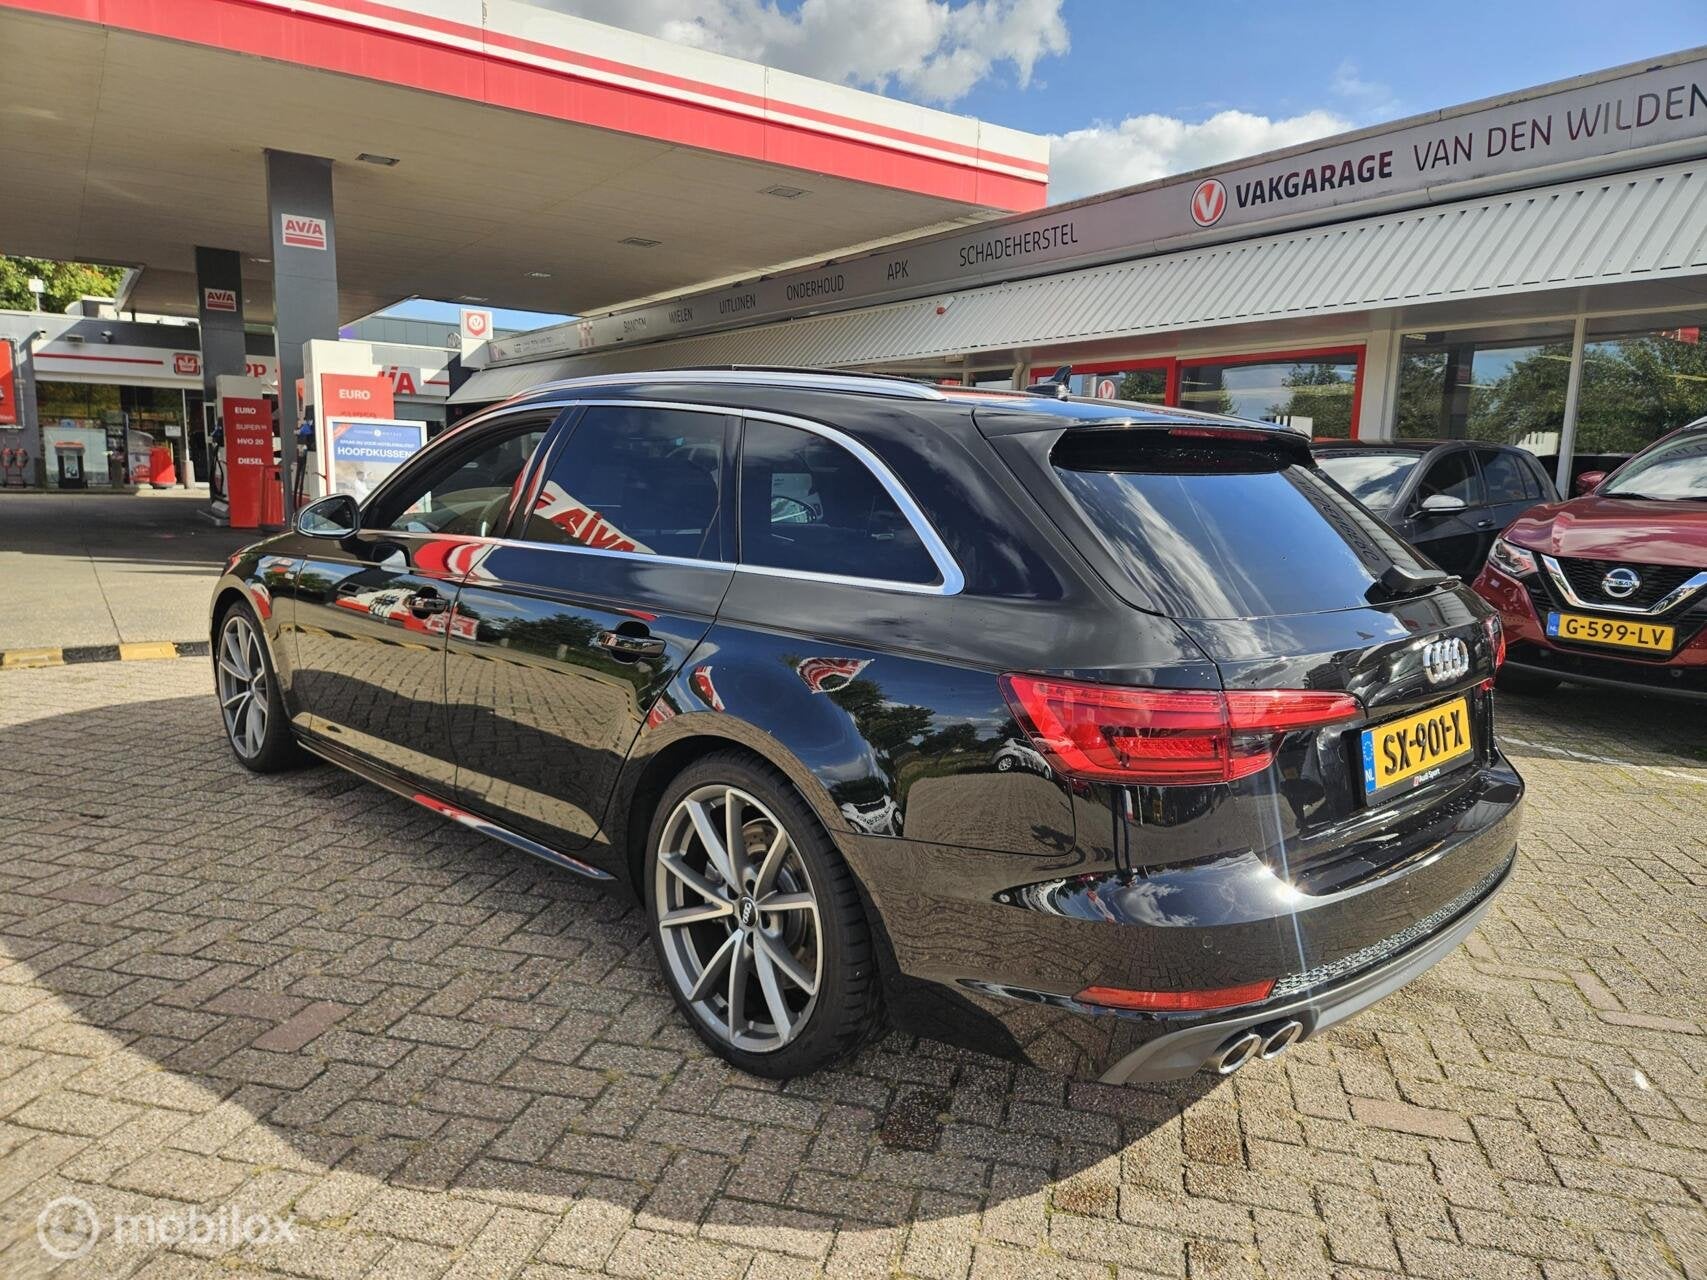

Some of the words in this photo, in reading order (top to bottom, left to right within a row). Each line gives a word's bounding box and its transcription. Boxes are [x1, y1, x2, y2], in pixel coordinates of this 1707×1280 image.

[1236, 151, 1393, 208] VAKGARAGE
[1414, 133, 1473, 171] VAN
[1487, 115, 1552, 158] DEN
[1567, 83, 1707, 141] WILDEN
[959, 222, 1078, 267] SCHADEHERSTEL
[887, 259, 910, 281] APK
[786, 274, 845, 301] ONDERHOUD
[668, 308, 694, 324] WIELEN
[338, 389, 371, 400] EURO
[234, 406, 256, 415] EURO
[237, 437, 254, 446] HVO
[238, 457, 264, 465] DIESEL
[1566, 618, 1665, 646] G-599-LV
[1365, 769, 1375, 782] NL
[1383, 709, 1463, 776] SX-901-X
